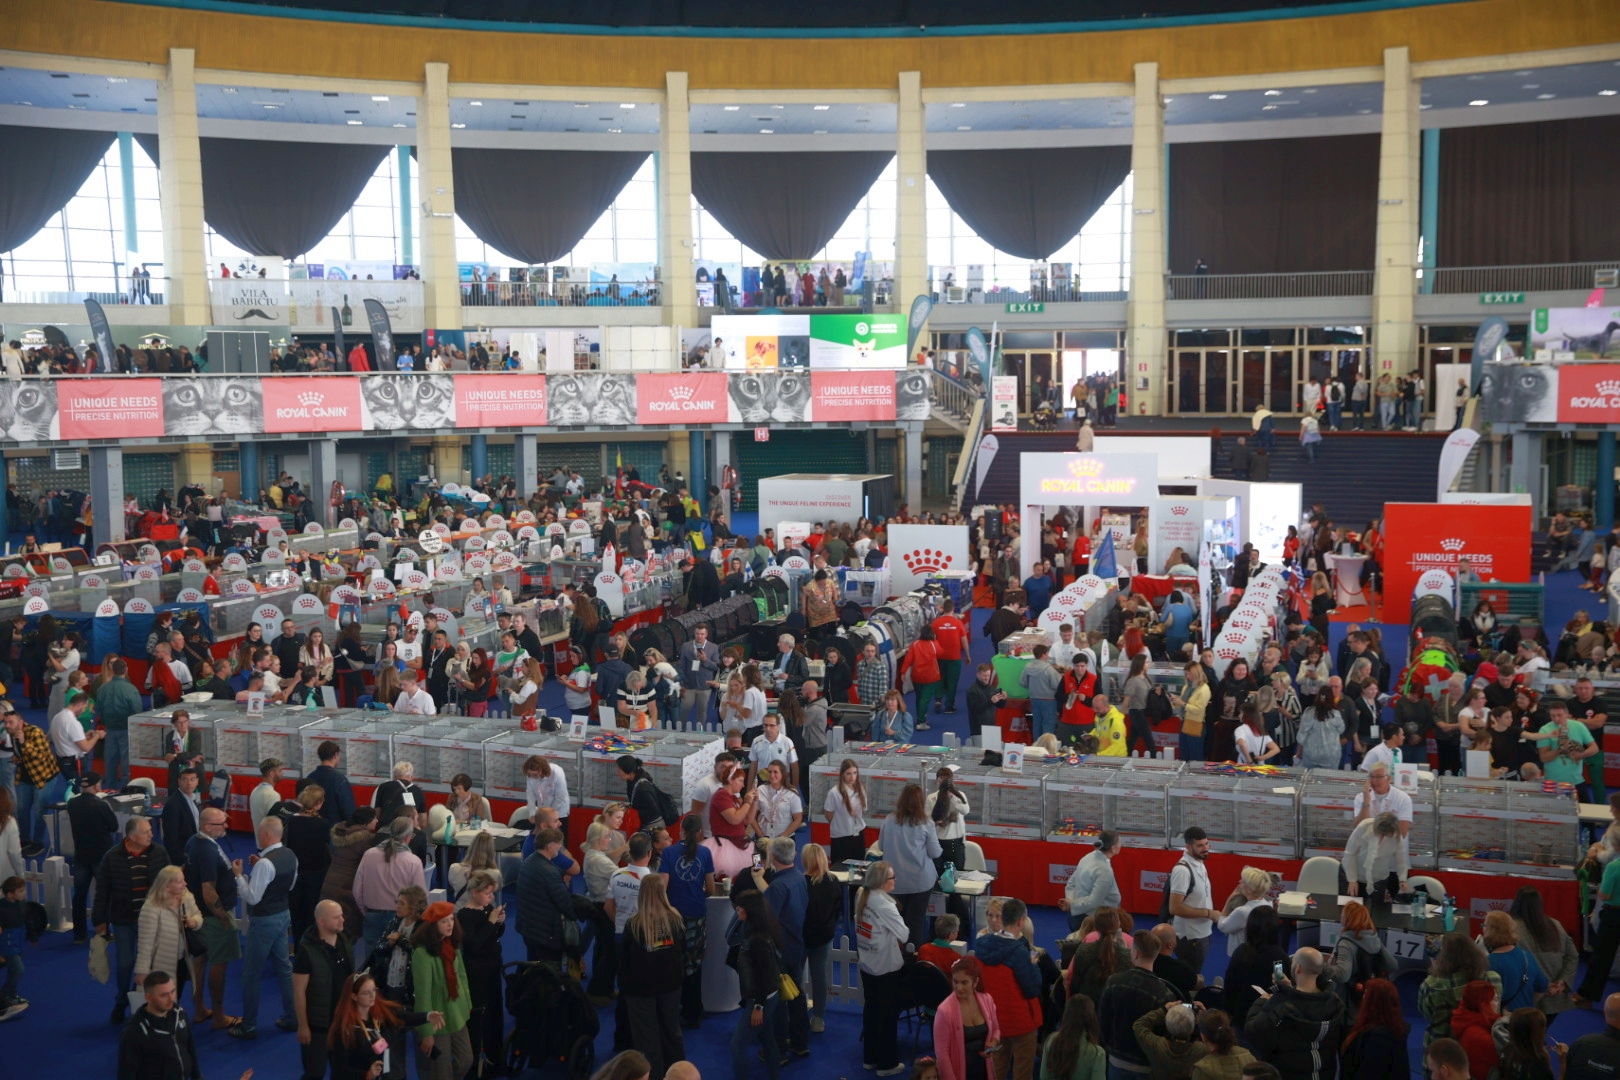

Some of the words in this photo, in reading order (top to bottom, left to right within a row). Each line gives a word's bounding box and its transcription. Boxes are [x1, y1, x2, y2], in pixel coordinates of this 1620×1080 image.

[240, 289, 268, 298] VILA
[1484, 292, 1520, 302] EXIT
[232, 298, 278, 306] BABICIU
[1010, 303, 1040, 312] EXIT
[469, 390, 508, 400] UNIQUE
[509, 390, 543, 399] NEEDS
[824, 386, 859, 396] UNIQUE
[861, 386, 892, 395] NEEDS
[74, 398, 118, 409] UNIQUE
[120, 396, 158, 407] NEEDS
[649, 401, 681, 411] ROYAL
[682, 400, 714, 410] CANIN
[1570, 396, 1608, 408] ROYAL
[276, 408, 310, 418] ROYAL
[312, 407, 348, 417] CANIN
[469, 403, 501, 412] PRECISE
[75, 411, 111, 421] PRECISE
[113, 411, 158, 420] NUTRITION
[1041, 479, 1084, 493] ROYAL
[1086, 479, 1131, 494] CANIN
[1416, 553, 1455, 562] UNIQUE
[1395, 939, 1420, 958] 17
